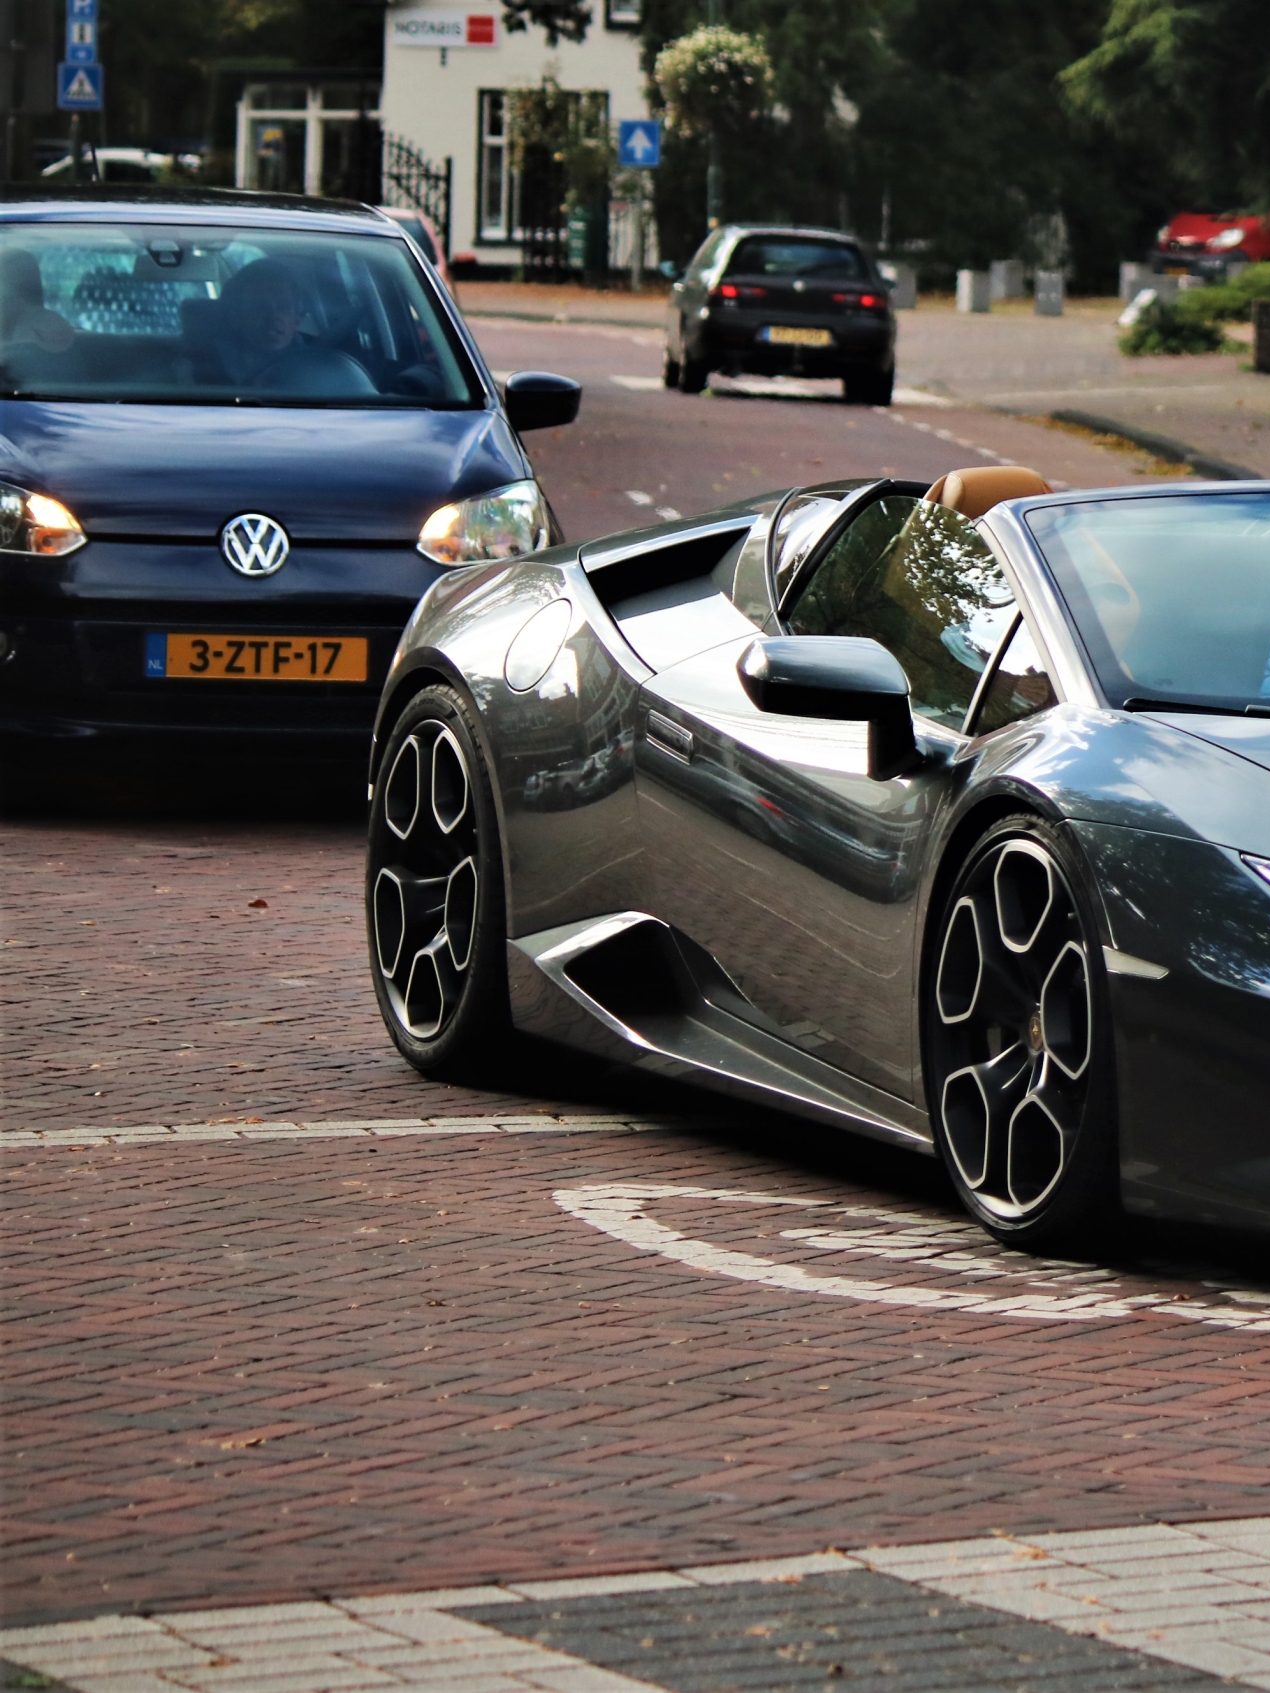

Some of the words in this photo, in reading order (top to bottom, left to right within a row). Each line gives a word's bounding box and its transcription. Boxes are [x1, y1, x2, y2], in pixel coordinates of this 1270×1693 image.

[395, 20, 462, 35] NOTARIS
[148, 659, 163, 670] NL
[189, 639, 343, 675] 3-ZTF-17
